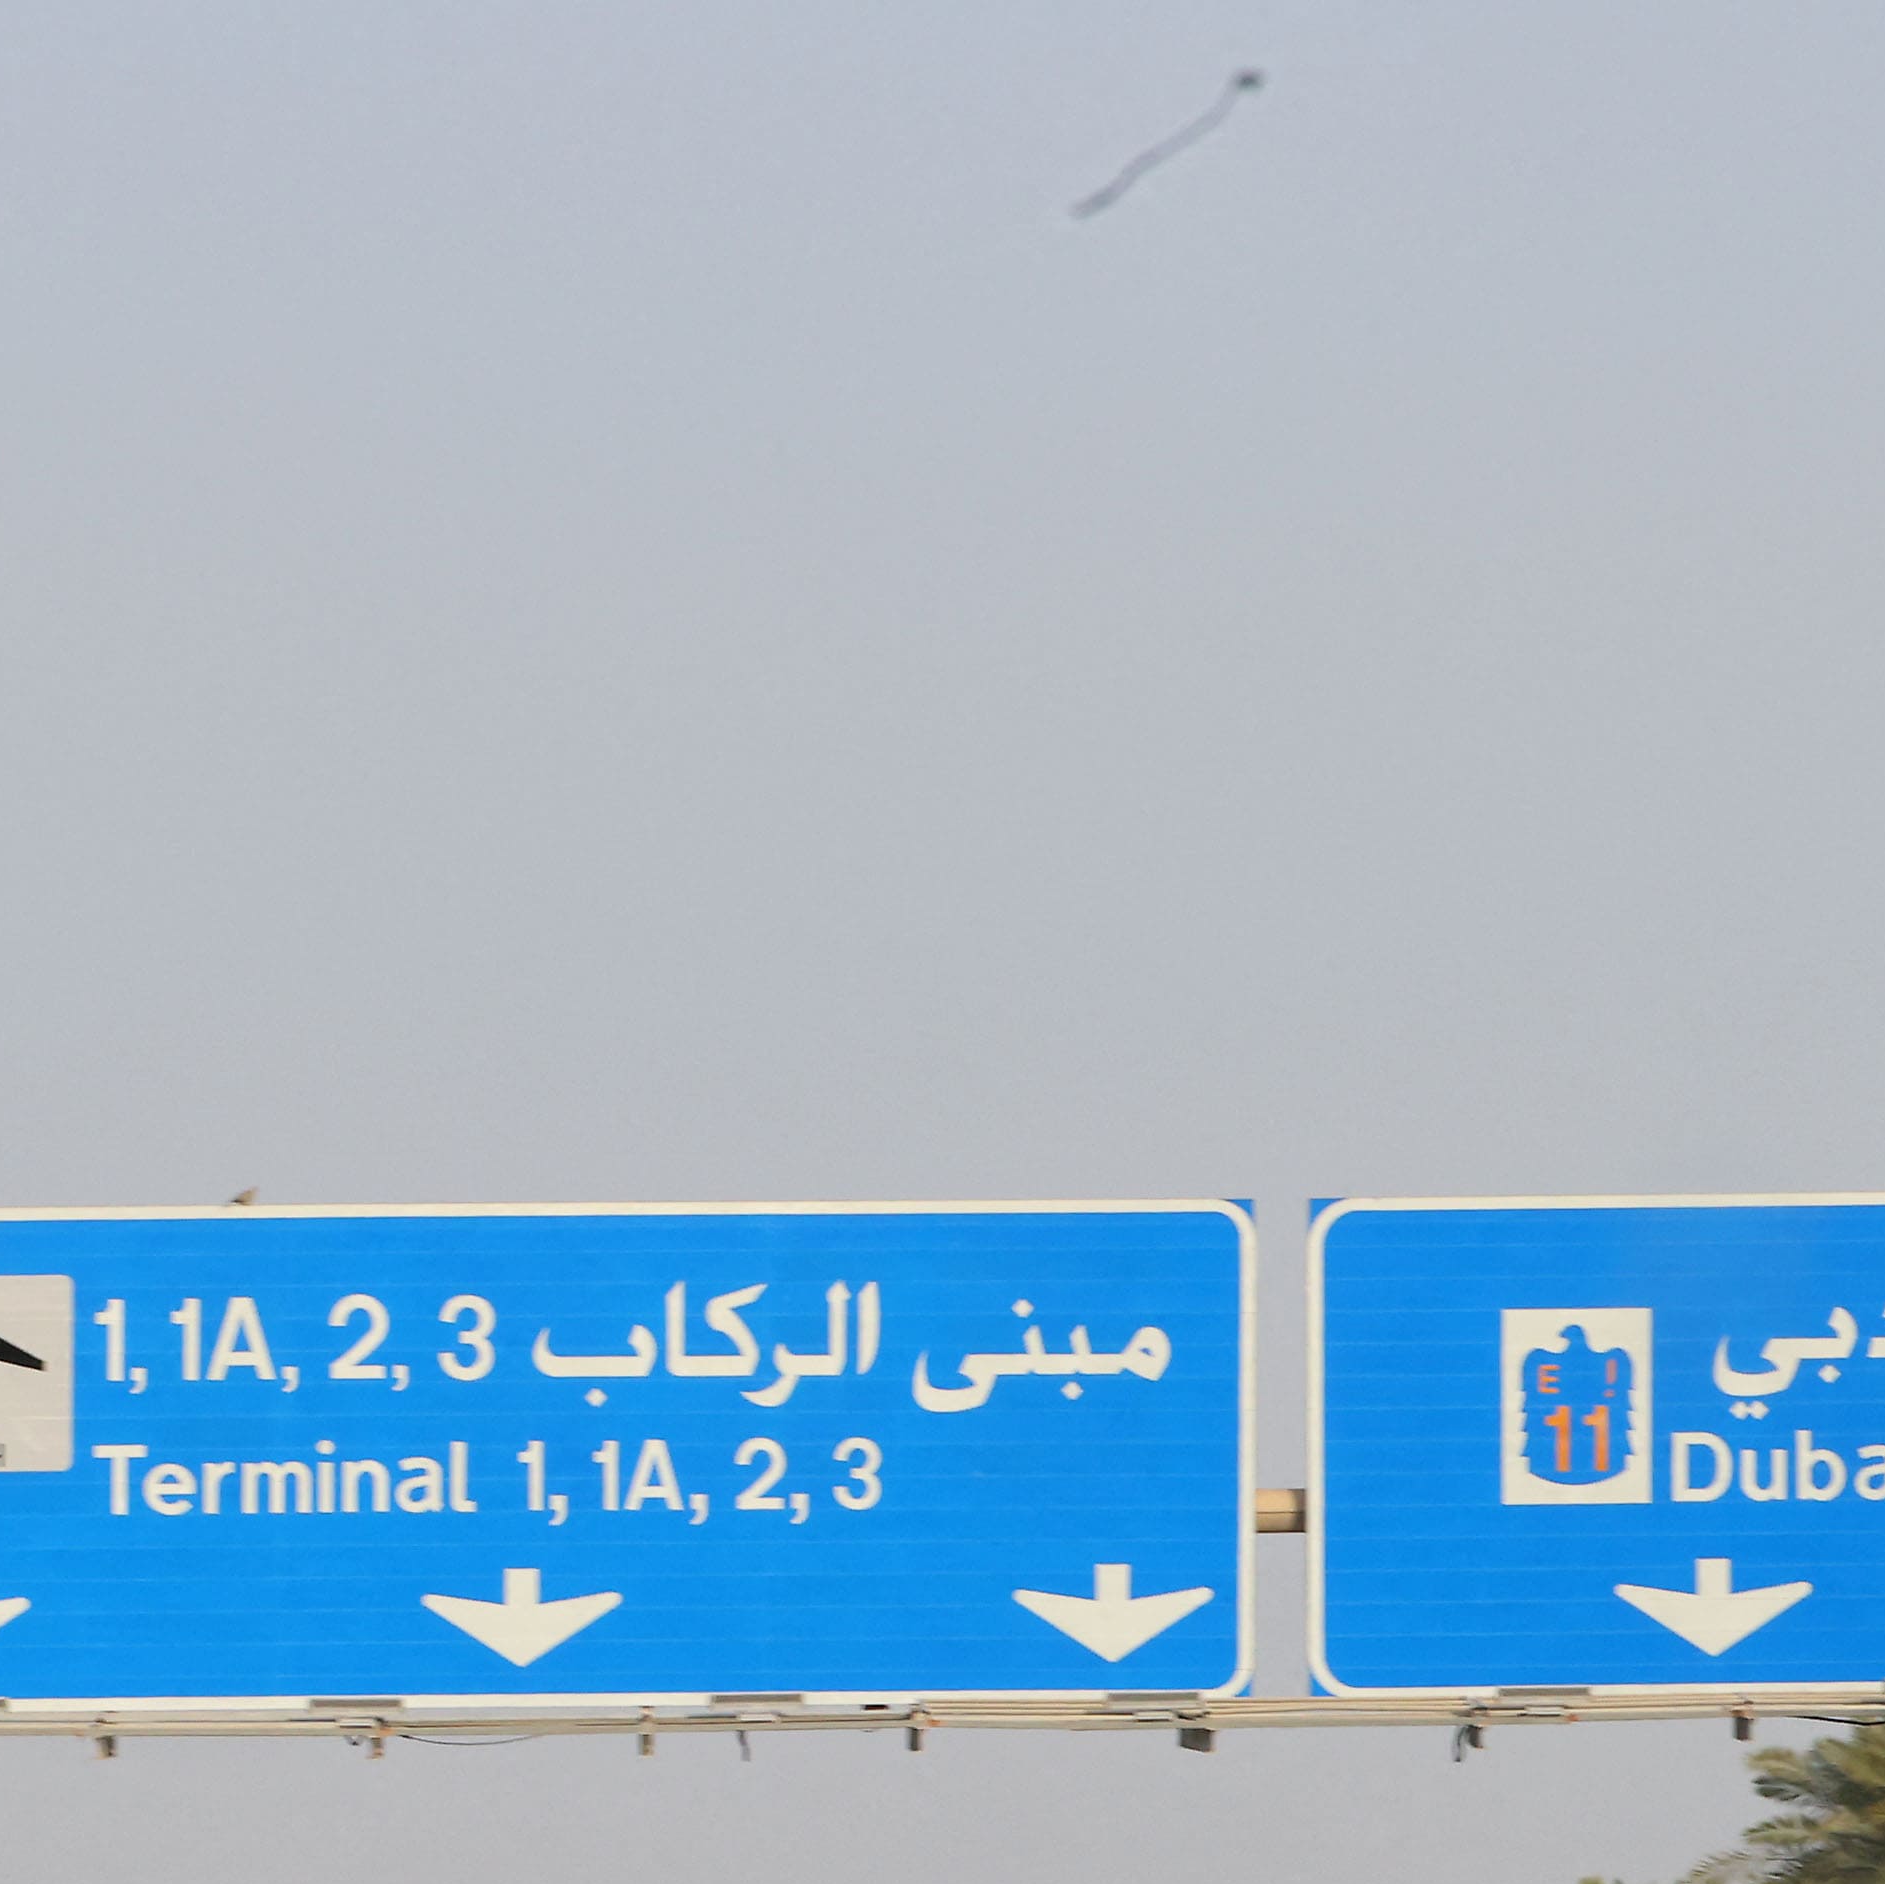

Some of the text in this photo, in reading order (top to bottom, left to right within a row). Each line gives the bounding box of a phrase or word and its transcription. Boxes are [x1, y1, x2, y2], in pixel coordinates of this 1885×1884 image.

[93, 1293, 496, 1394] 1, 1A, 2, 3
[531, 1281, 1172, 1413] مبنى الركاب
[1537, 1363, 1561, 1394] E
[91, 1436, 882, 1526] Terminal 1, 1A, 2, 3
[1544, 1404, 1610, 1472] 11
